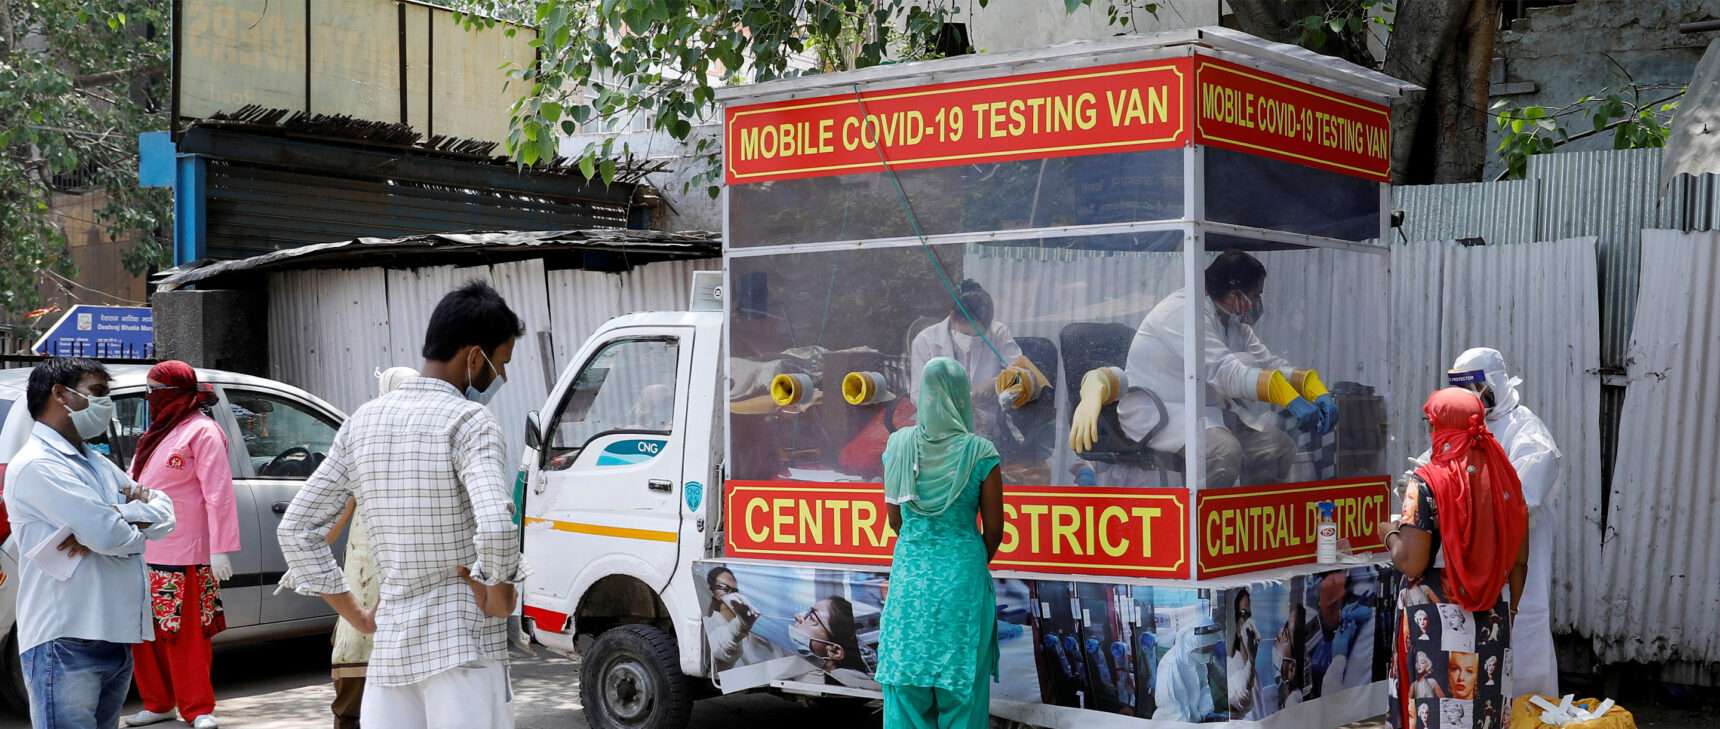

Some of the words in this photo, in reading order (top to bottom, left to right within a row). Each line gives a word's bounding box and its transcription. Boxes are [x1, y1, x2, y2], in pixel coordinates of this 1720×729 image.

[740, 119, 834, 160] MOBILE
[843, 106, 963, 149] COVID-19
[972, 92, 1097, 138] TESTING
[1106, 84, 1169, 128] VAN
[1202, 83, 1255, 128] MOBILE
[1257, 94, 1314, 143] COVID-19
[1315, 111, 1363, 152] TESTING
[1365, 124, 1387, 160] VAN
[637, 441, 659, 454] CNG
[686, 488, 701, 496] CNG
[998, 502, 1162, 559] STRICT
[1206, 504, 1300, 557] CENTRAL
[1306, 495, 1384, 544] DTRICT
